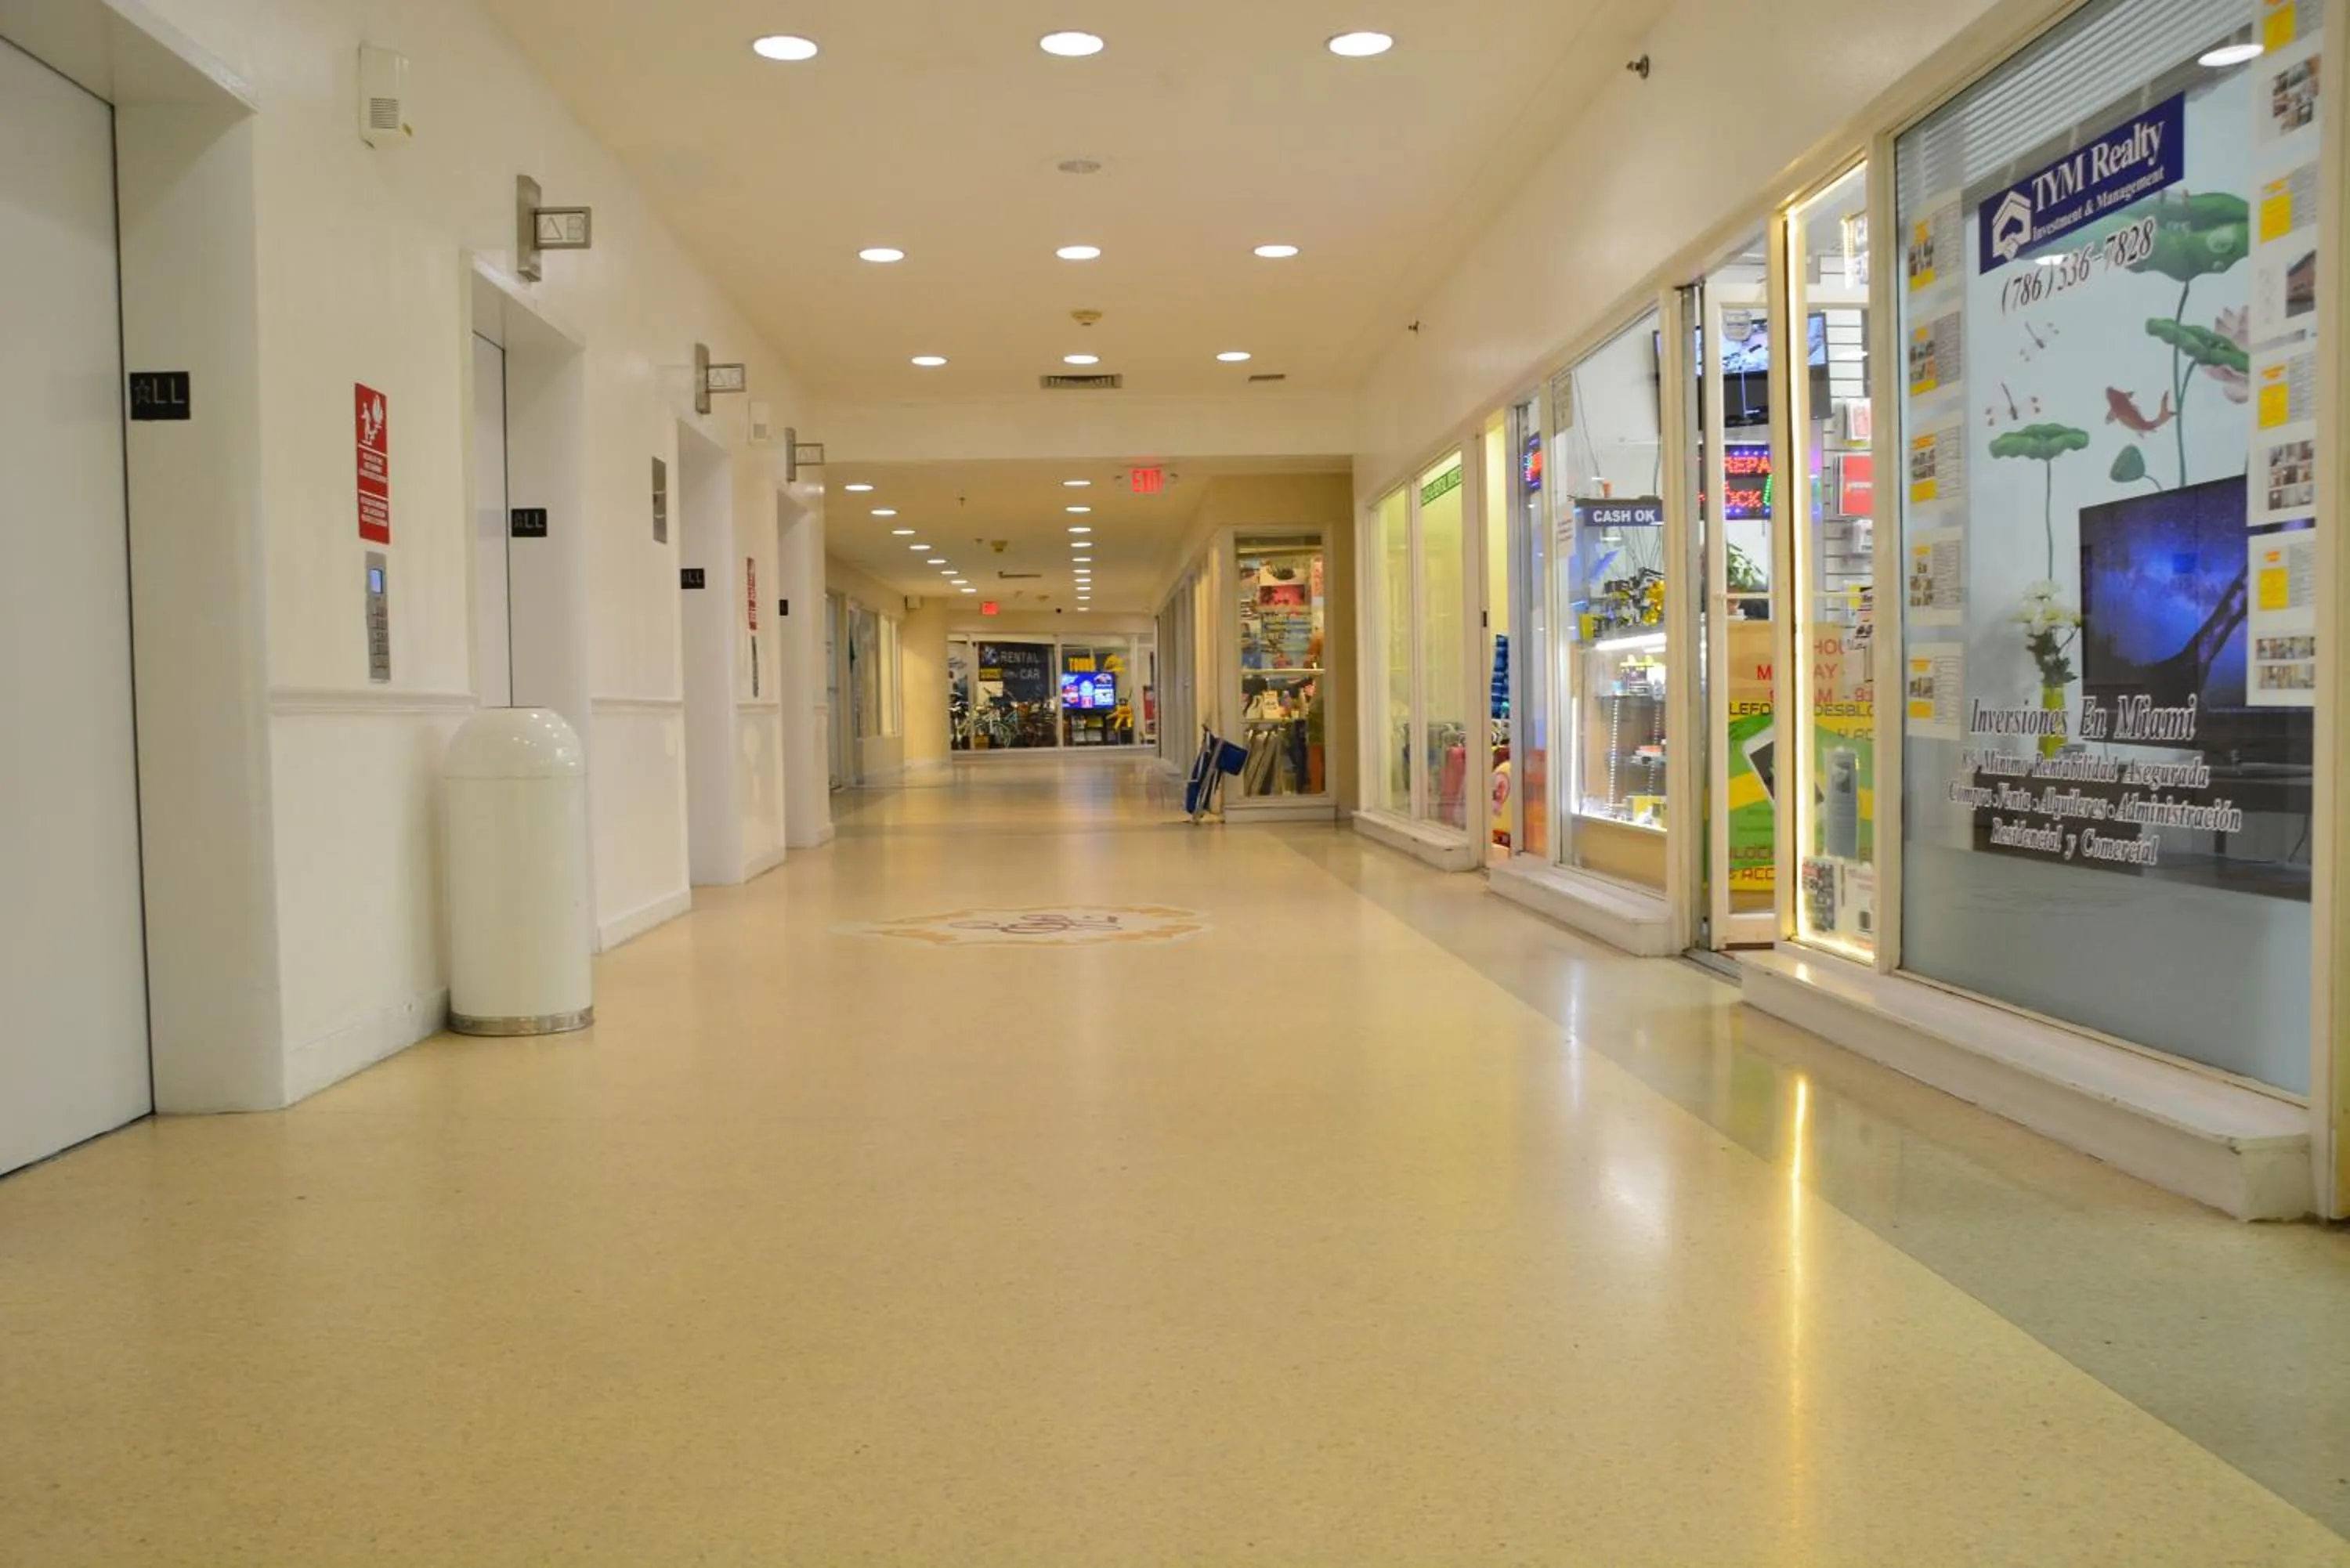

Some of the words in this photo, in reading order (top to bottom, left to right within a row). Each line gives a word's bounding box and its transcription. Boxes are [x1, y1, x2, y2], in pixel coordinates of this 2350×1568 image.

[2031, 156, 2084, 212] TYM
[2090, 121, 2165, 185] Realty
[2033, 205, 2083, 242] Investment
[2084, 199, 2095, 217] &
[2095, 165, 2165, 211] Management
[1592, 509, 1631, 523] CASH
[1634, 509, 1655, 523] OK
[1000, 651, 1040, 663] RENTAL
[1019, 668, 1040, 680] CAR
[1969, 696, 2068, 735] Inversiones
[2079, 695, 2107, 739] En
[2114, 694, 2197, 741] Miami
[2121, 756, 2211, 790] Asegurada
[2063, 833, 2076, 861] y
[2081, 828, 2160, 865] Comercial
